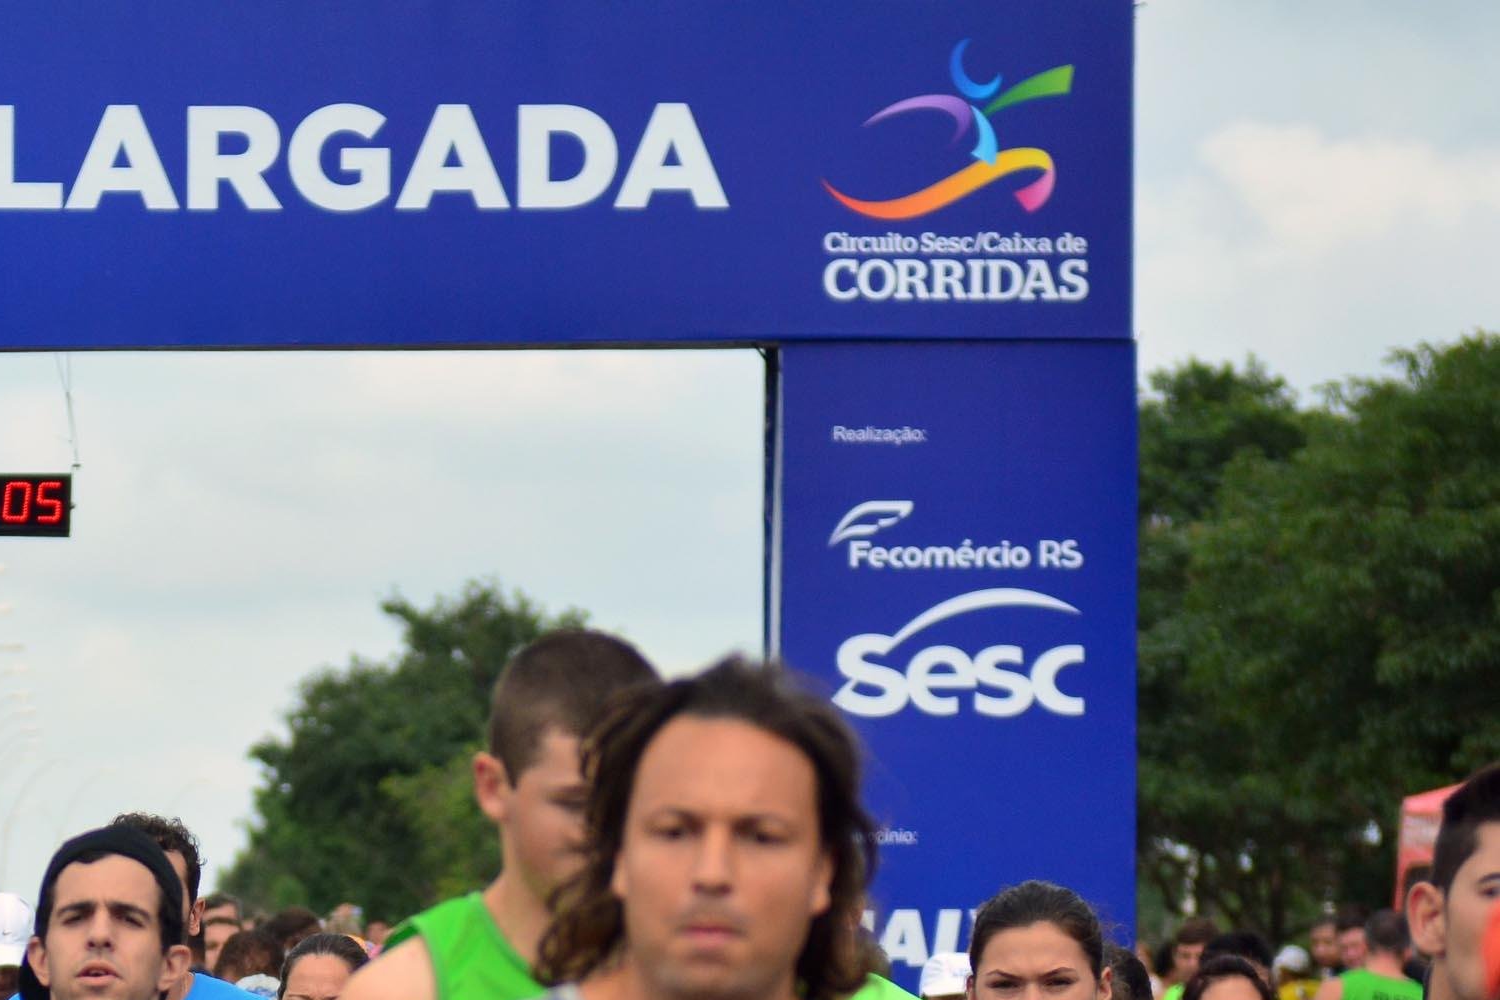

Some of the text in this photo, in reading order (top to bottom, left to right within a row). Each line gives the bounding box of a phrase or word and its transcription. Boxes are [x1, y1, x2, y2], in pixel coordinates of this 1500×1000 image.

[823, 232, 1088, 254] Circuito Sesc/Caixa de
[823, 258, 1090, 301] CORRIDAS
[832, 425, 927, 446] Realização:
[2, 482, 62, 522] 05
[849, 538, 1083, 568] Fecomércio RS
[831, 632, 1085, 718] Sesc
